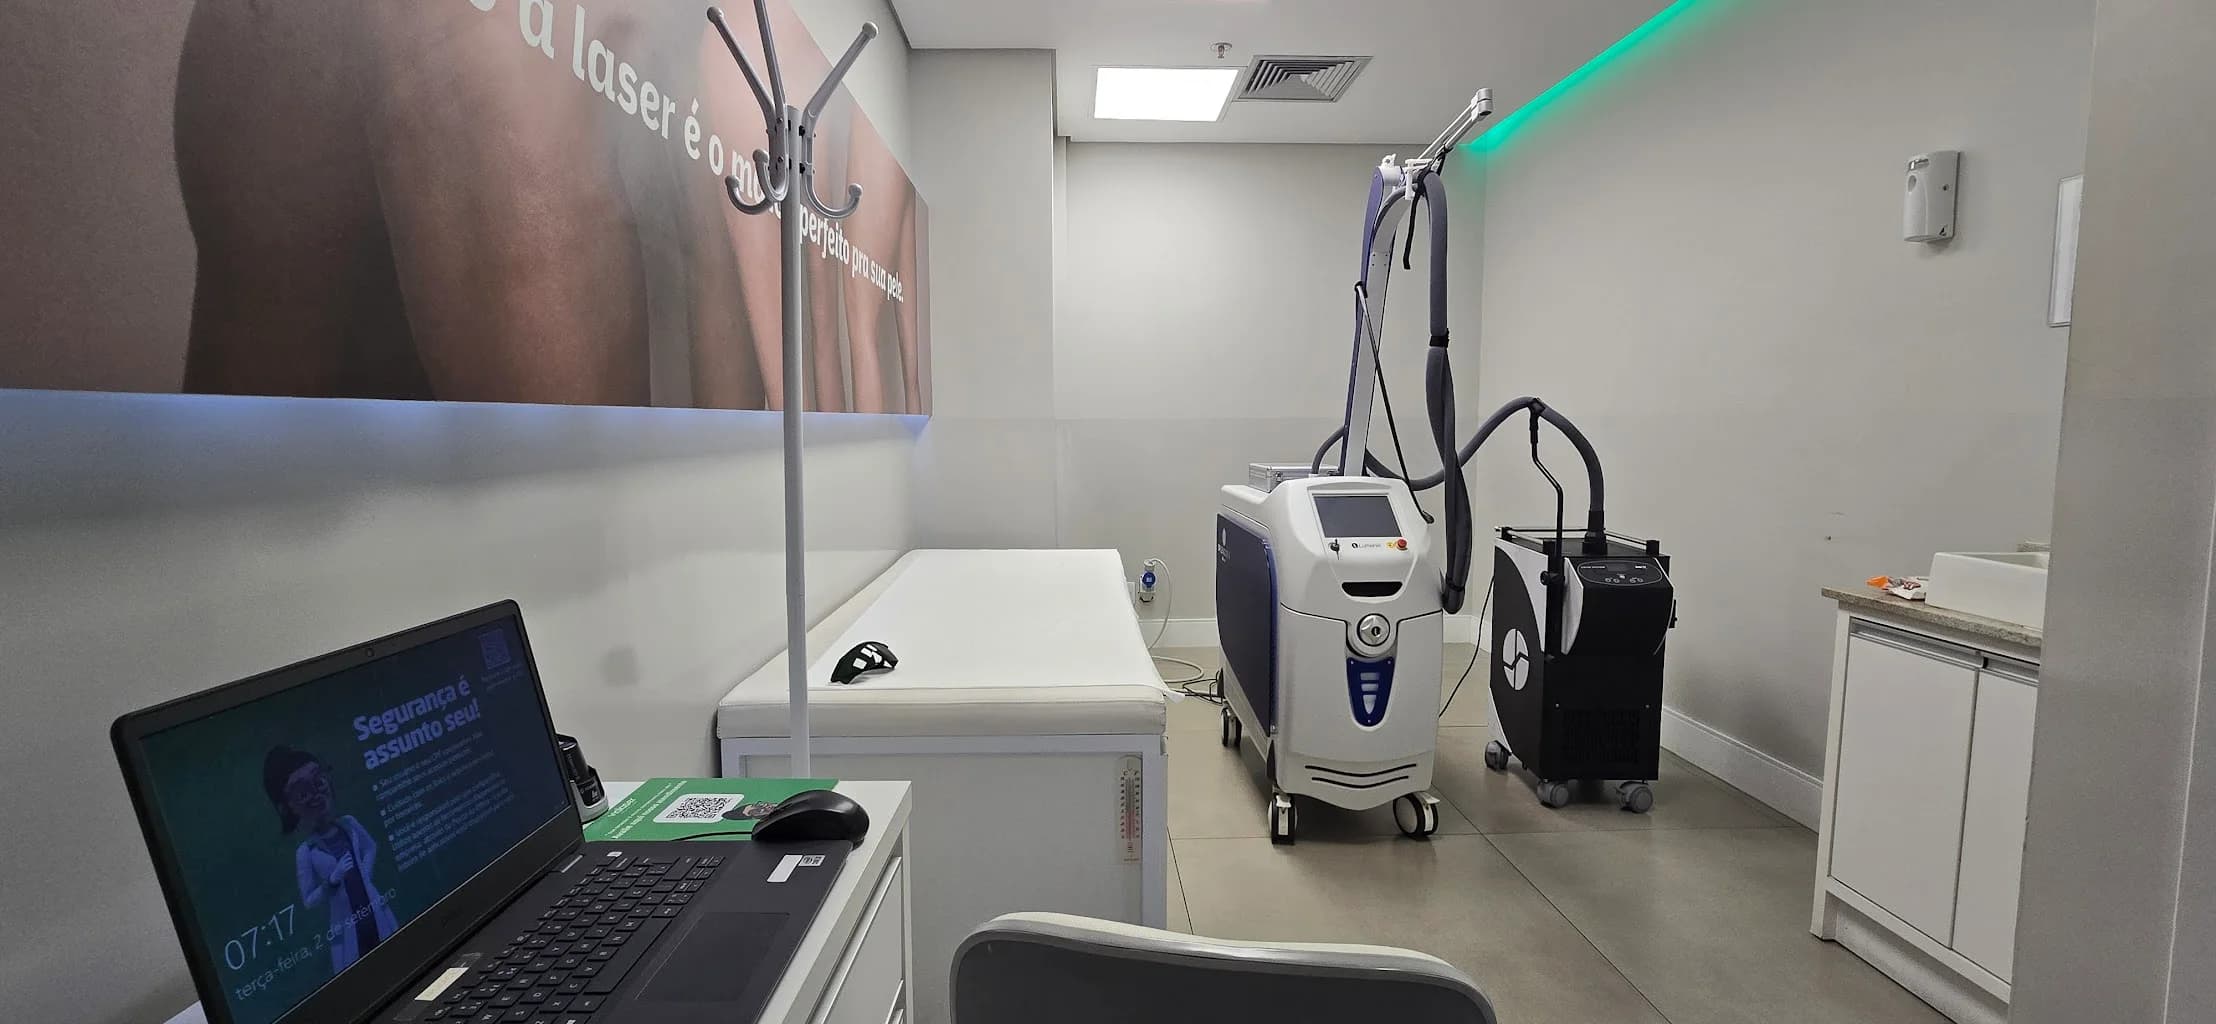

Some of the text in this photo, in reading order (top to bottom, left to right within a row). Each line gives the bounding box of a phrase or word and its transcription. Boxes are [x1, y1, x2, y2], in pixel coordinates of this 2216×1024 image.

[572, 4, 676, 140] laser
[684, 98, 701, 160] é
[708, 134, 724, 176] o
[799, 204, 850, 265] perfeito
[852, 245, 869, 279] pra
[870, 259, 887, 292] sua
[887, 271, 904, 303] pele.
[353, 685, 457, 742] Segurança
[458, 674, 471, 697] é
[363, 720, 443, 770] assunto
[444, 697, 481, 732] seu!
[225, 904, 295, 971] 07:17
[235, 946, 313, 1001] terça-feira,
[313, 934, 324, 951] 2
[326, 922, 343, 942] de
